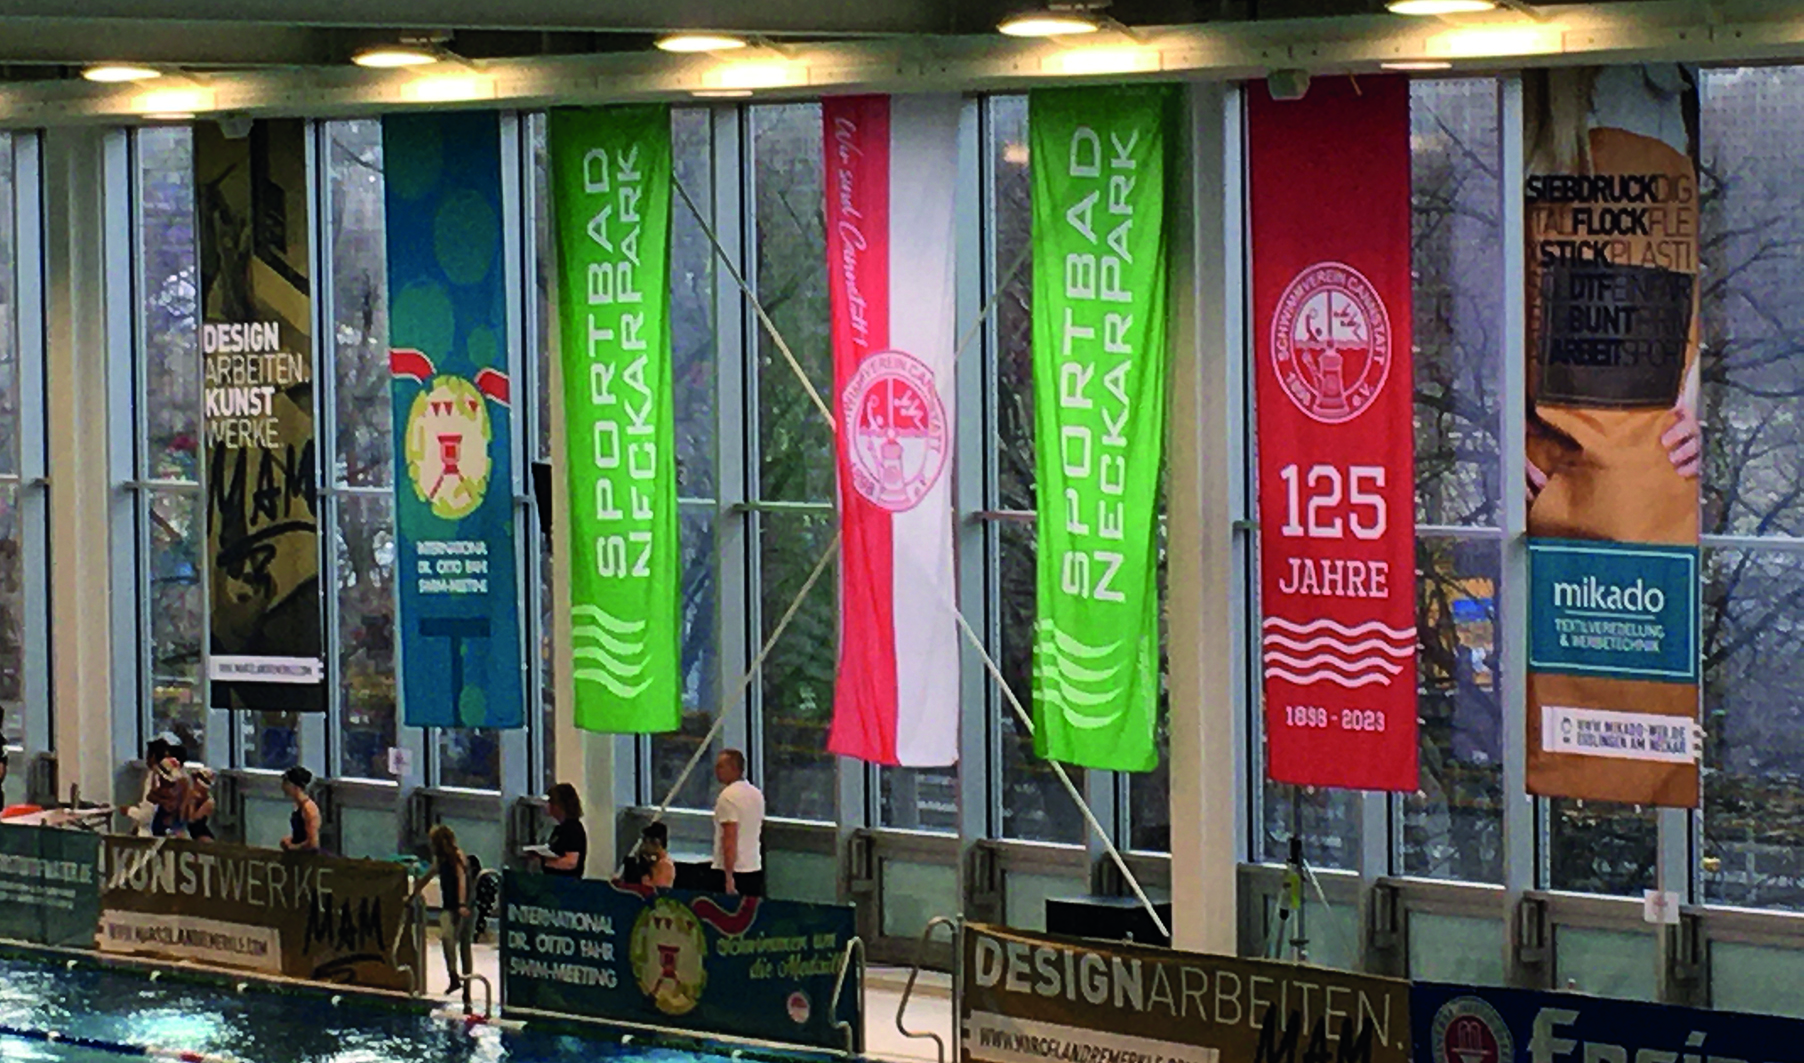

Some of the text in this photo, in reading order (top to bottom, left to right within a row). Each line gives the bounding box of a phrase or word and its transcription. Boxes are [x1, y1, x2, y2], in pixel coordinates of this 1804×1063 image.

[203, 321, 280, 354] DESIGN
[205, 353, 310, 385] ARBEITEN.
[582, 147, 628, 579] SPORTBAD
[1061, 126, 1101, 599] SPORTBAD
[1093, 129, 1139, 603] NECKARPARK
[205, 385, 275, 418] KUNST
[1280, 464, 1387, 541] 125
[1279, 557, 1389, 599] JAHRE
[1553, 575, 1666, 614] mikado
[535, 933, 576, 956] OTTO
[974, 936, 1404, 1051] DESIGNARBEITEN.
